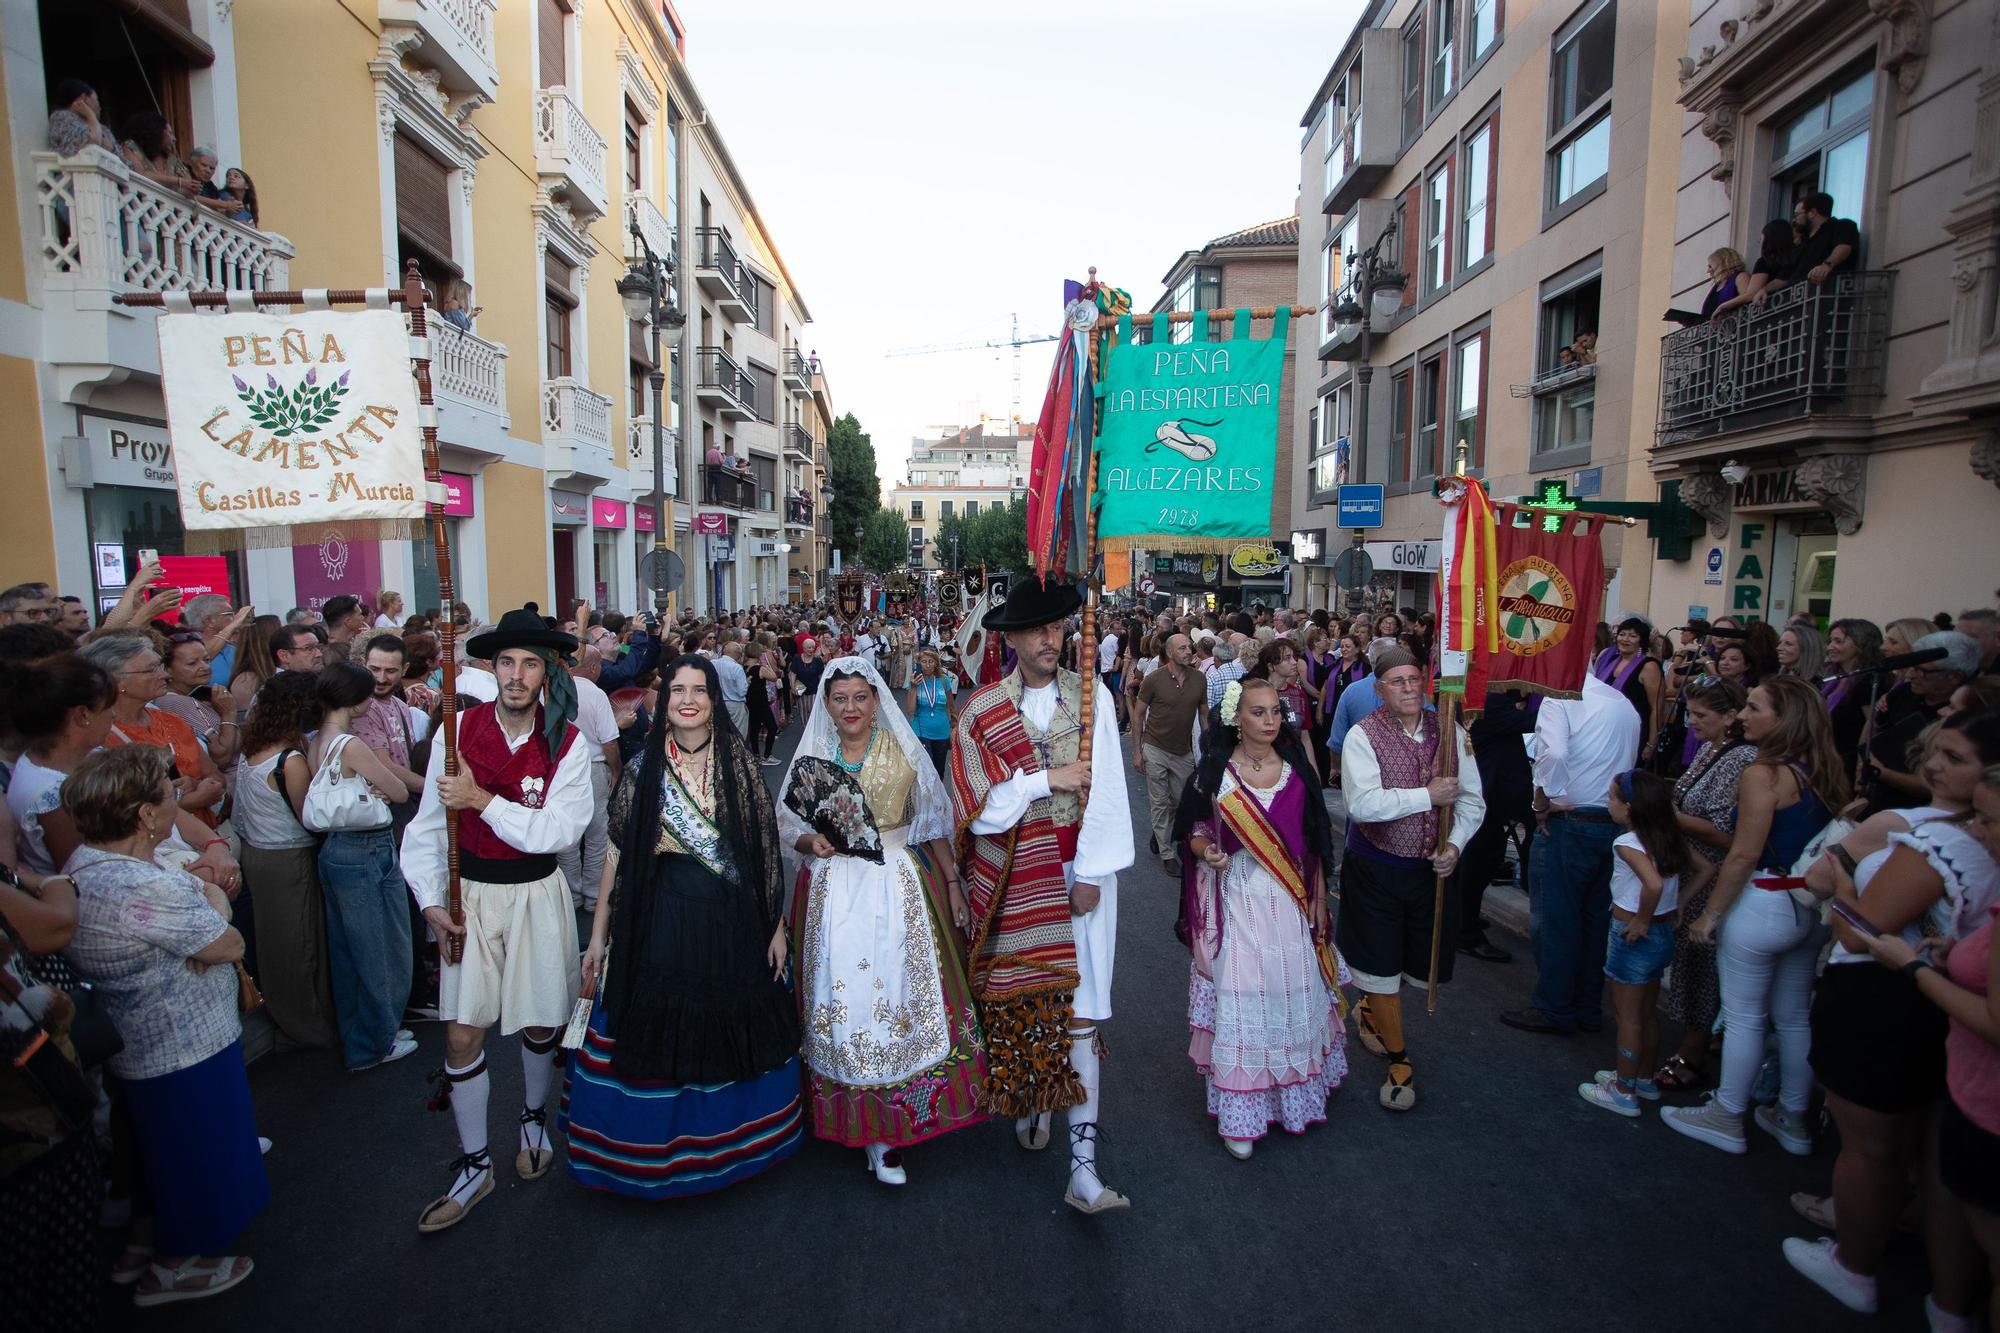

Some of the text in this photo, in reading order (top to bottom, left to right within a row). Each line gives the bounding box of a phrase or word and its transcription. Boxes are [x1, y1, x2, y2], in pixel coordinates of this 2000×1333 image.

[223, 328, 346, 367] PEÑA
[1152, 348, 1230, 376] PEÑA
[1109, 383, 1271, 413] LA ESPARTEÑA
[144, 467, 174, 483] Grupo
[1107, 467, 1262, 491] ALGEZARES
[198, 481, 301, 512] Casillas
[327, 472, 414, 502] Murcia
[1157, 507, 1199, 526] 1978
[666, 805, 691, 835] Peña
